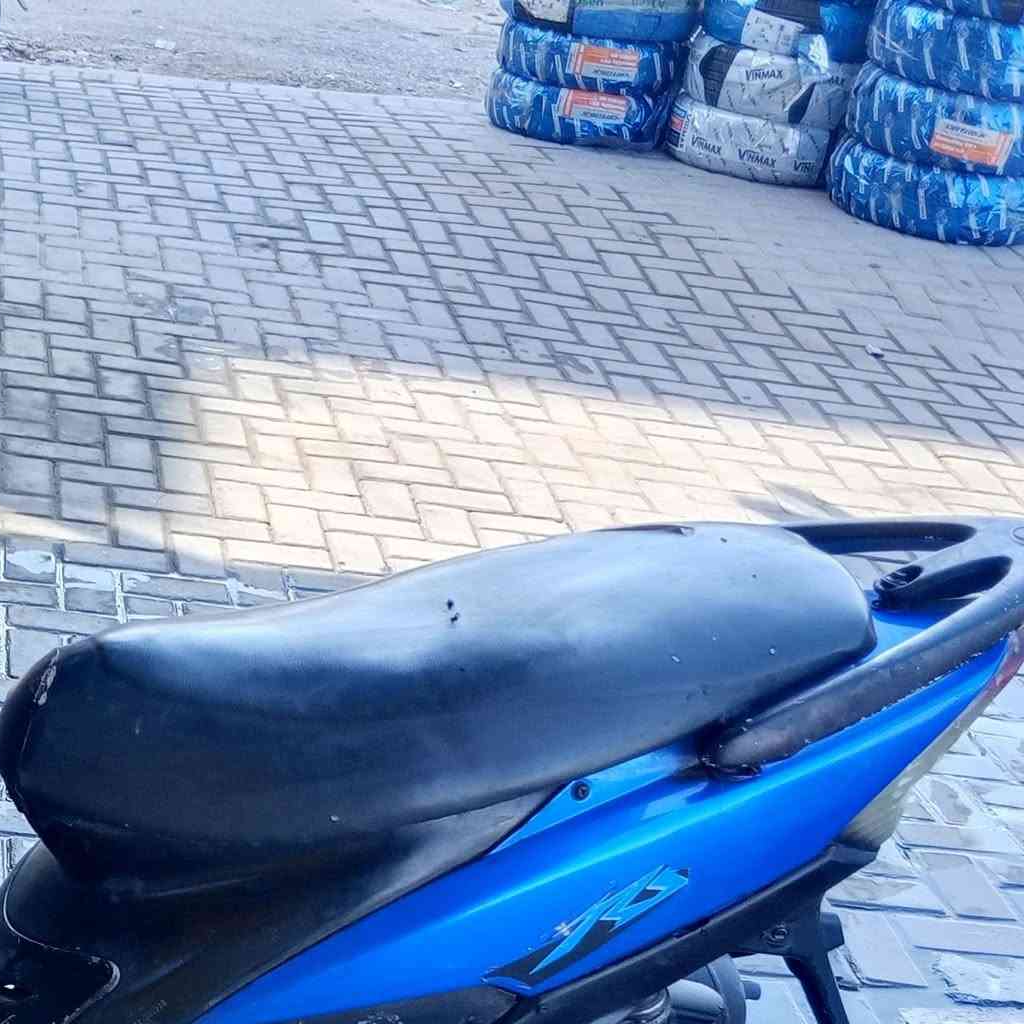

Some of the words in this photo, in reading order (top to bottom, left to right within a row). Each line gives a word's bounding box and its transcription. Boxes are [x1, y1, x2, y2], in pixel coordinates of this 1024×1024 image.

[745, 68, 783, 81] VINMAX
[692, 135, 721, 155] VINMAX
[738, 148, 777, 167] VINMAX
